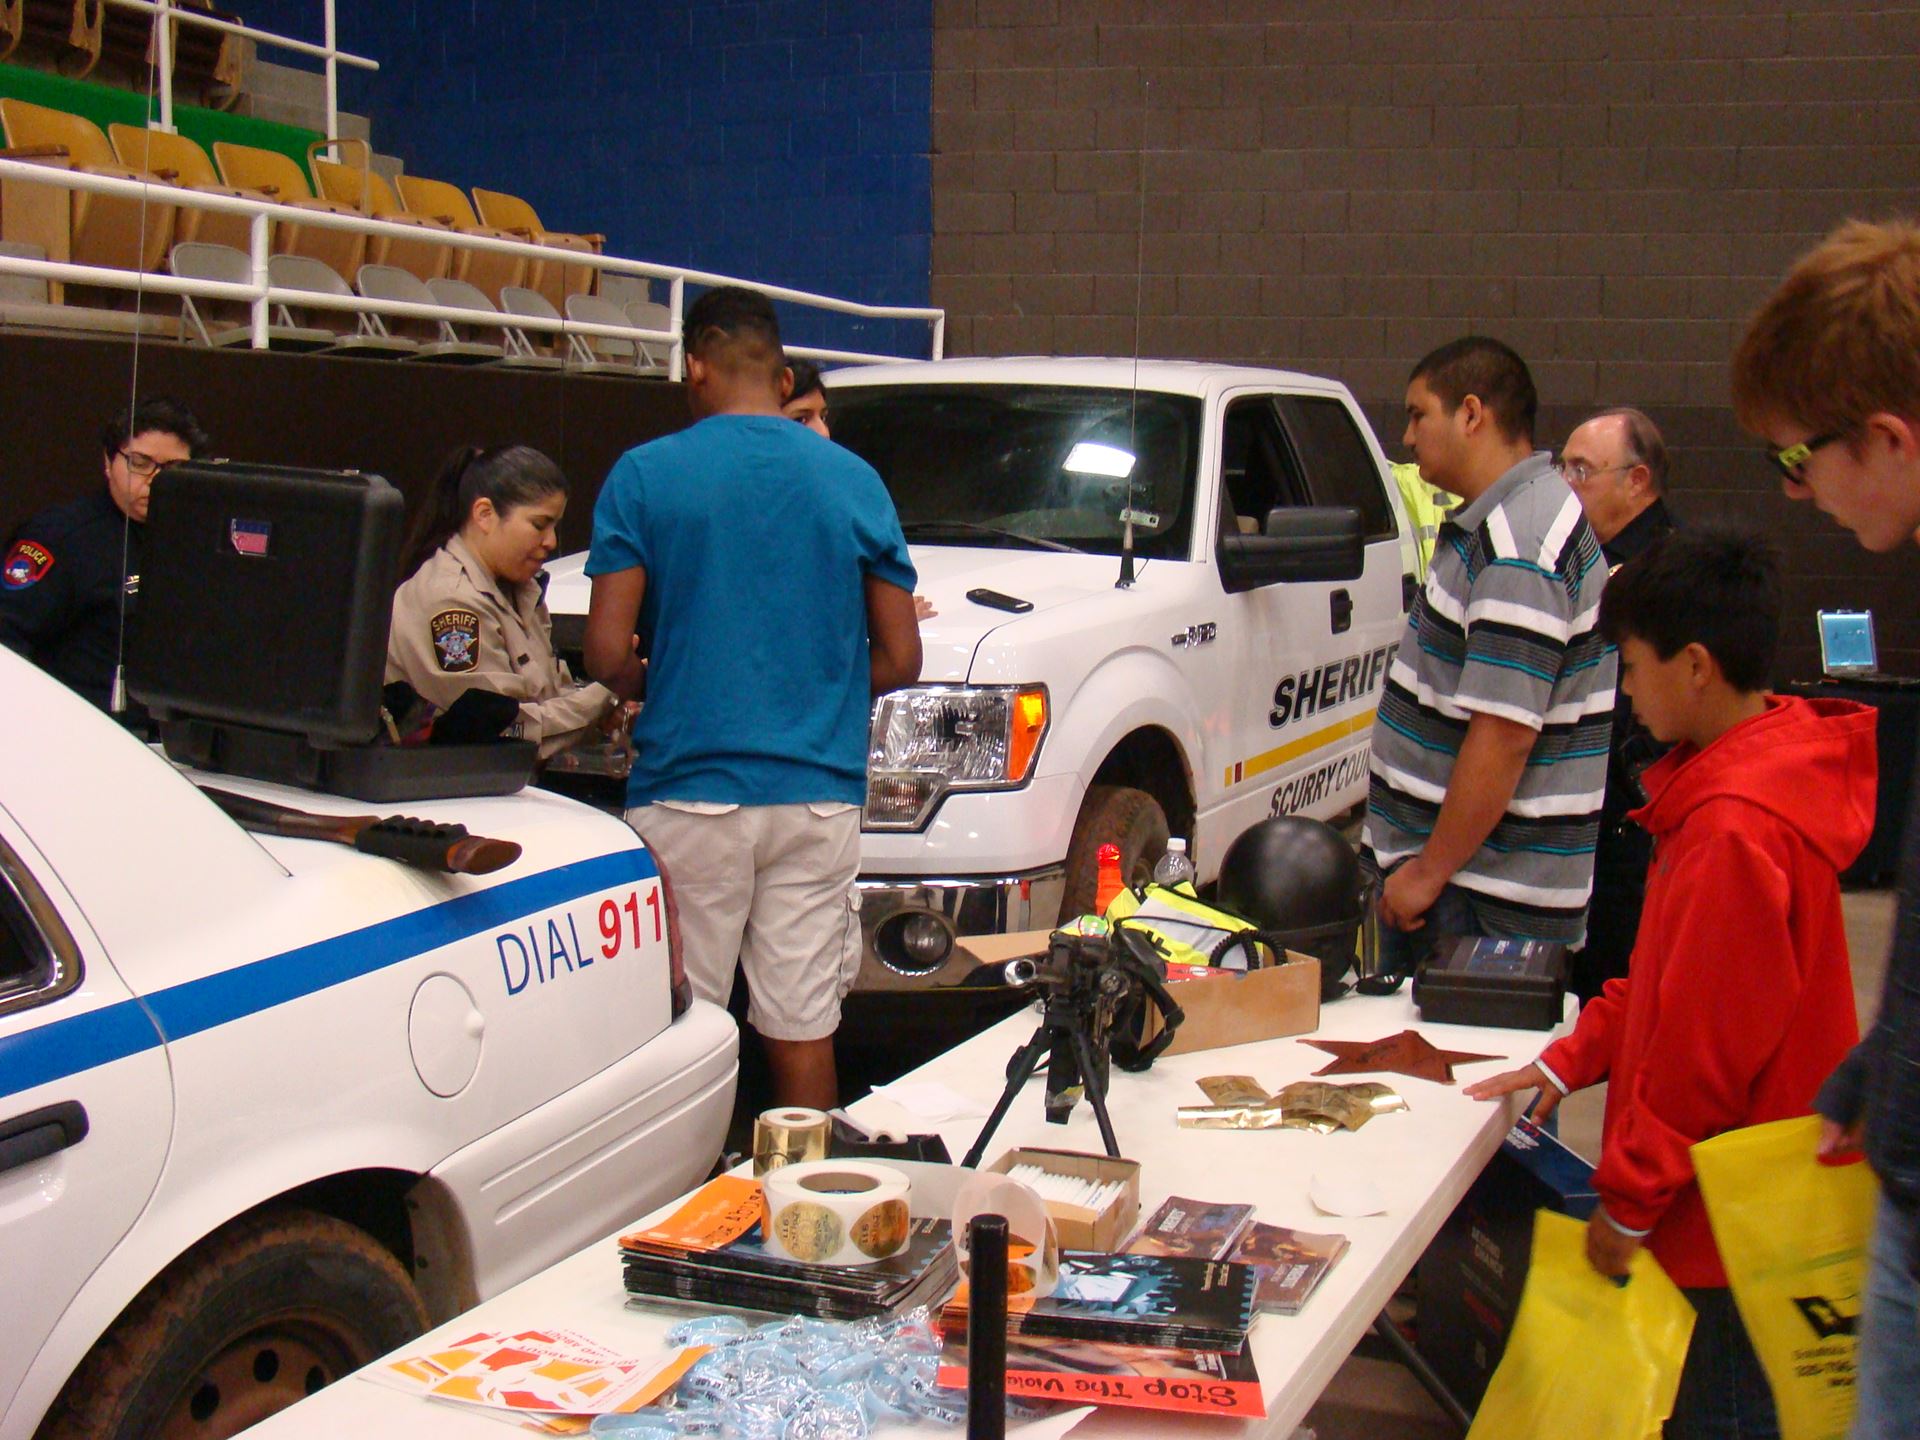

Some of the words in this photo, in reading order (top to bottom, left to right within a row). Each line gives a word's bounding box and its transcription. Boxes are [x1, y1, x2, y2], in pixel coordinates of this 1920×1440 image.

[19, 544, 48, 566] POLICE
[431, 613, 478, 632] SHERIFF
[1268, 641, 1400, 730] SHERIFF
[1267, 762, 1338, 819] SCURRY
[495, 912, 594, 996] DIAL
[598, 885, 662, 960] 911
[519, 1345, 570, 1359] ABOUT
[571, 1357, 604, 1365] AND
[1075, 1378, 1133, 1400] The
[1143, 1378, 1237, 1407] Stop
